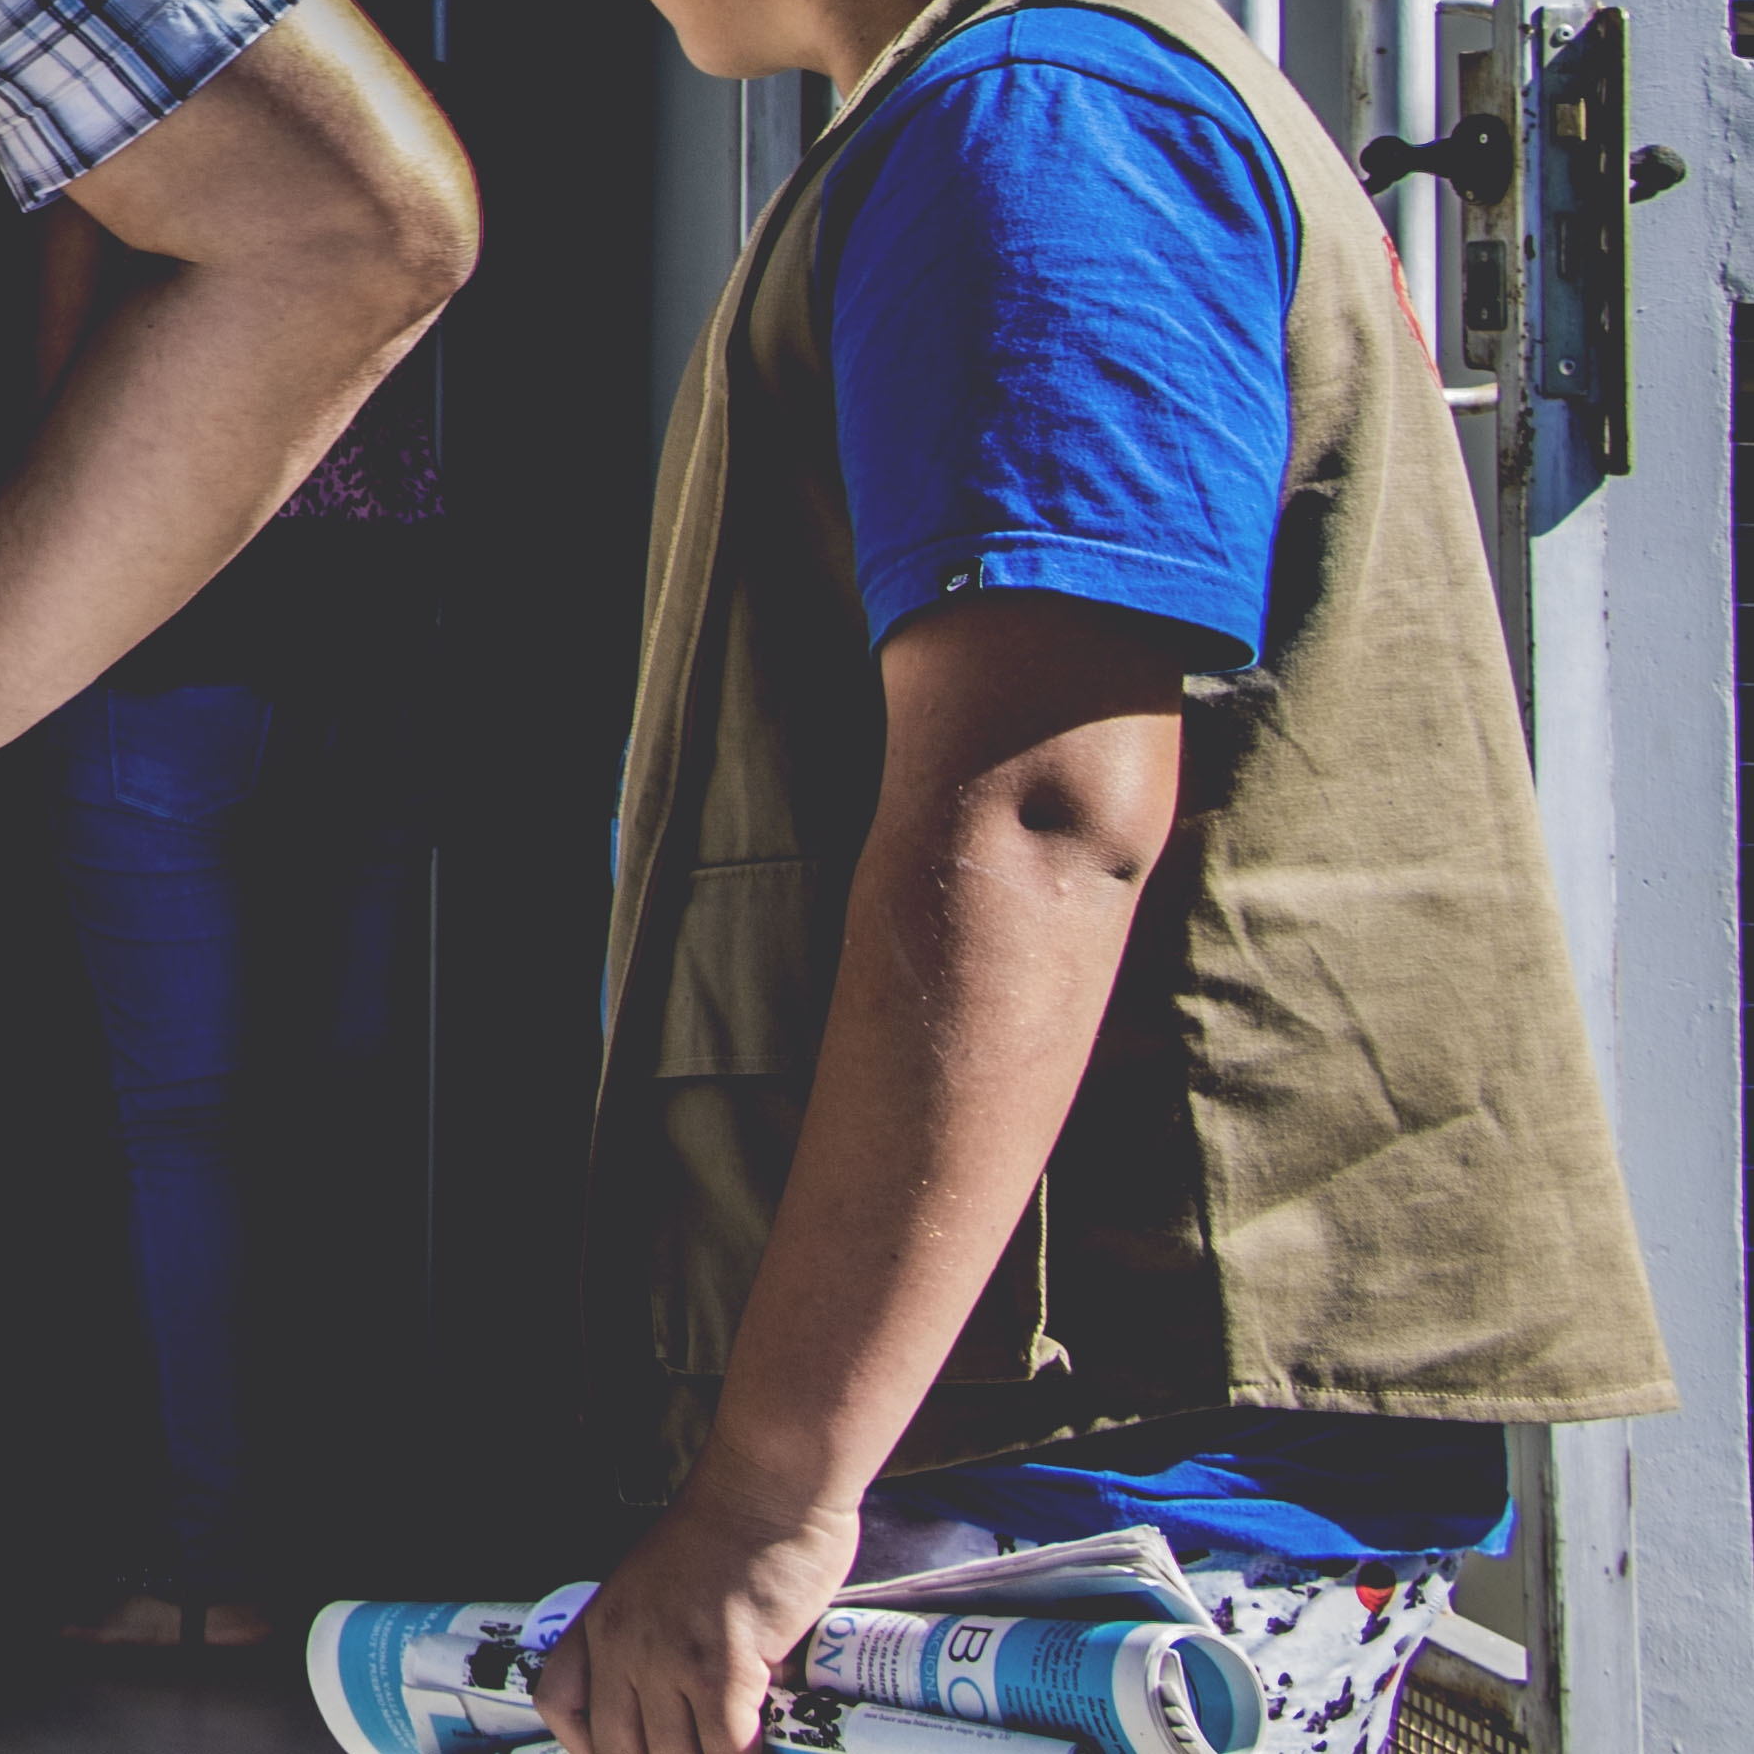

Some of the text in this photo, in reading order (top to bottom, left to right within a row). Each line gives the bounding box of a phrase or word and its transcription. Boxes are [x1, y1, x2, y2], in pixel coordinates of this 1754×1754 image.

[856, 1634, 872, 1681] Ceferino
[867, 1629, 885, 1692] Civilización
[879, 1661, 889, 1695] teatro
